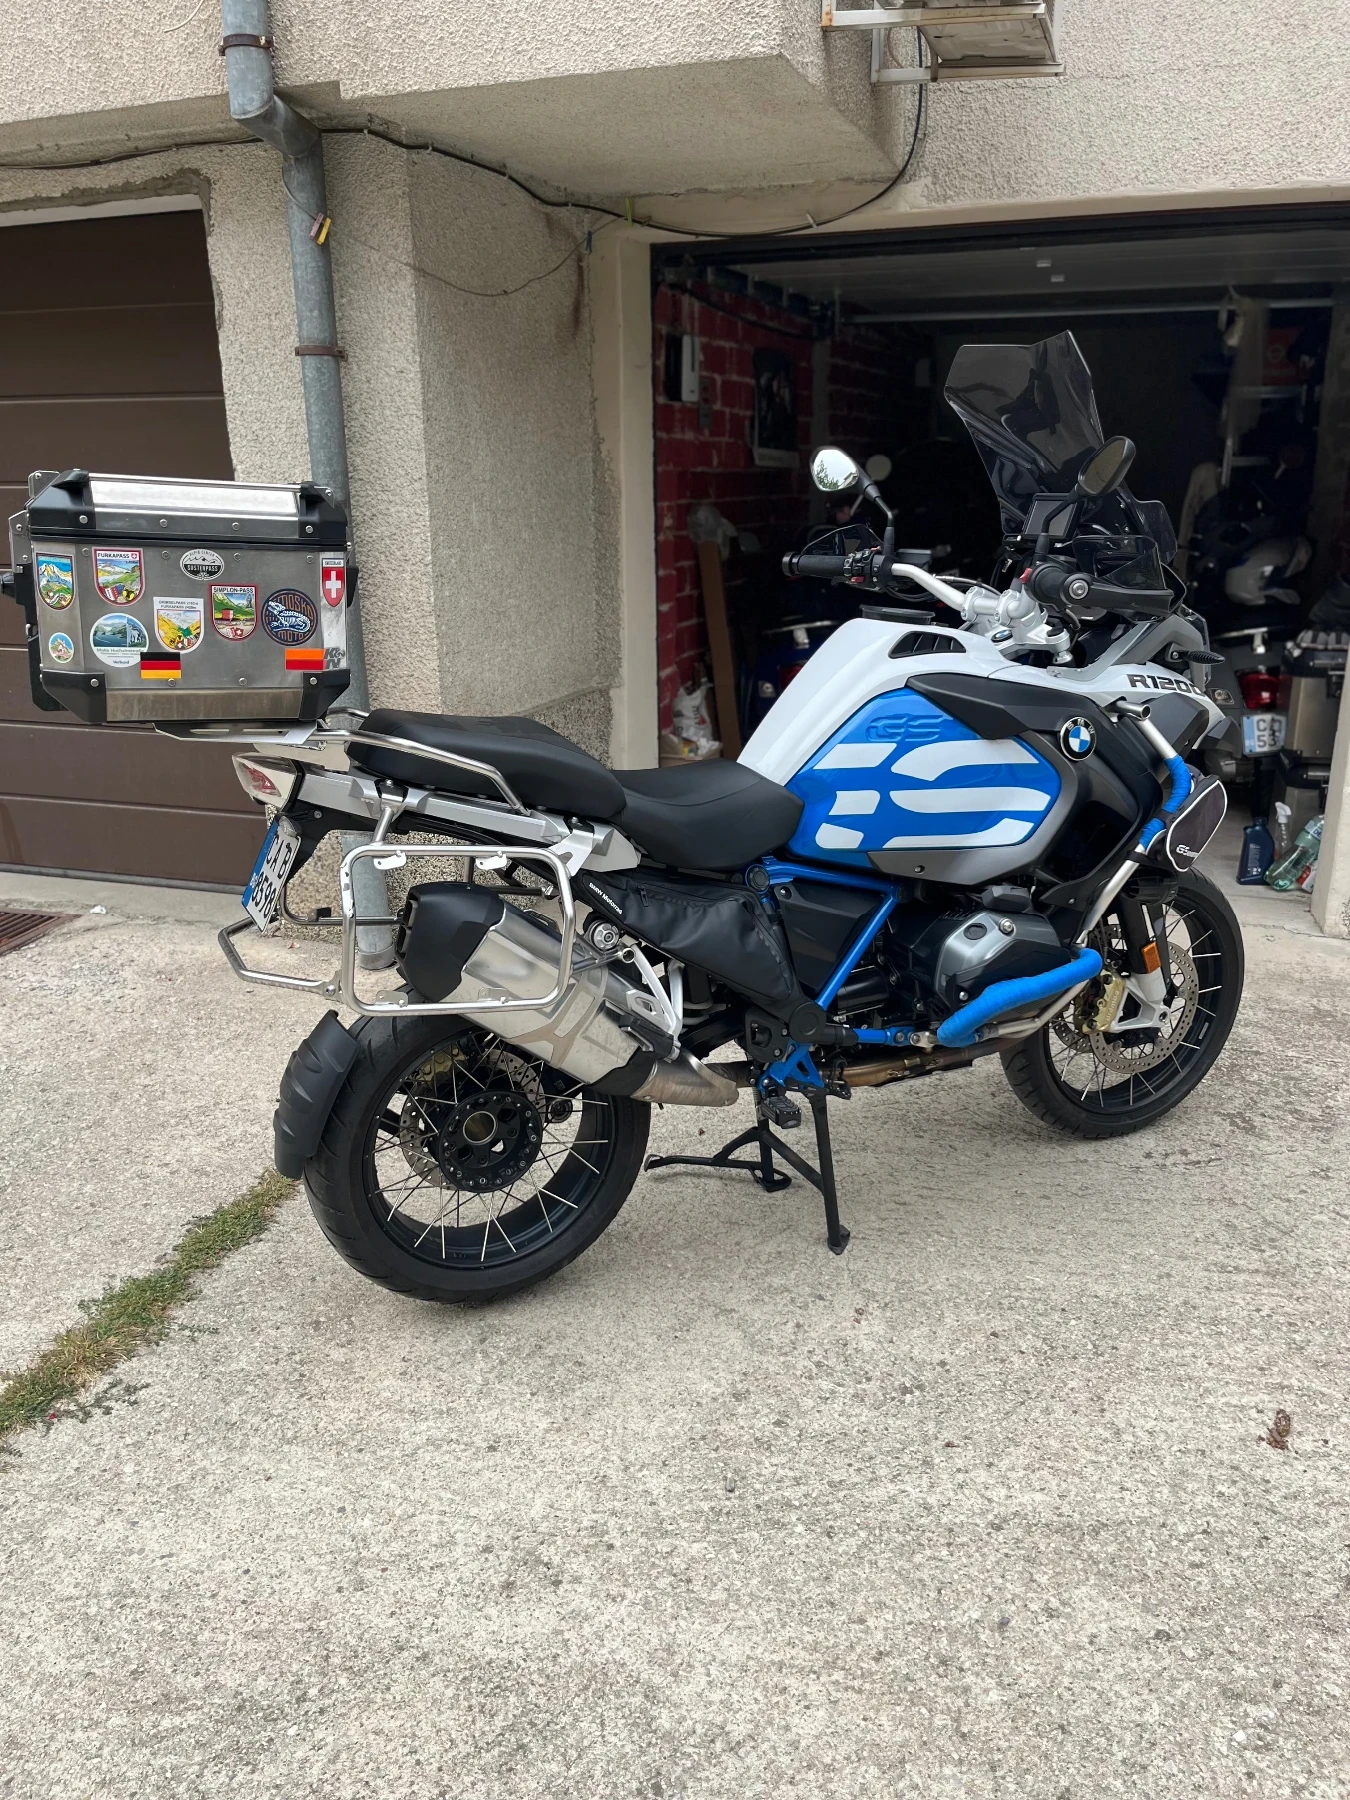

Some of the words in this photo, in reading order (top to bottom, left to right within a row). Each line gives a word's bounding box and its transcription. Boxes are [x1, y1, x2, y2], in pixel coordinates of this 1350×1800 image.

[187, 564, 218, 572] SUSTENPASS
[213, 586, 254, 594] SIMPLON-PASS
[278, 631, 303, 641] MOTO
[864, 713, 944, 743] GS
[1066, 718, 1096, 735] BMW
[252, 871, 277, 919] 8598
[588, 882, 603, 896] BMW
[602, 893, 623, 915] Motorrad
